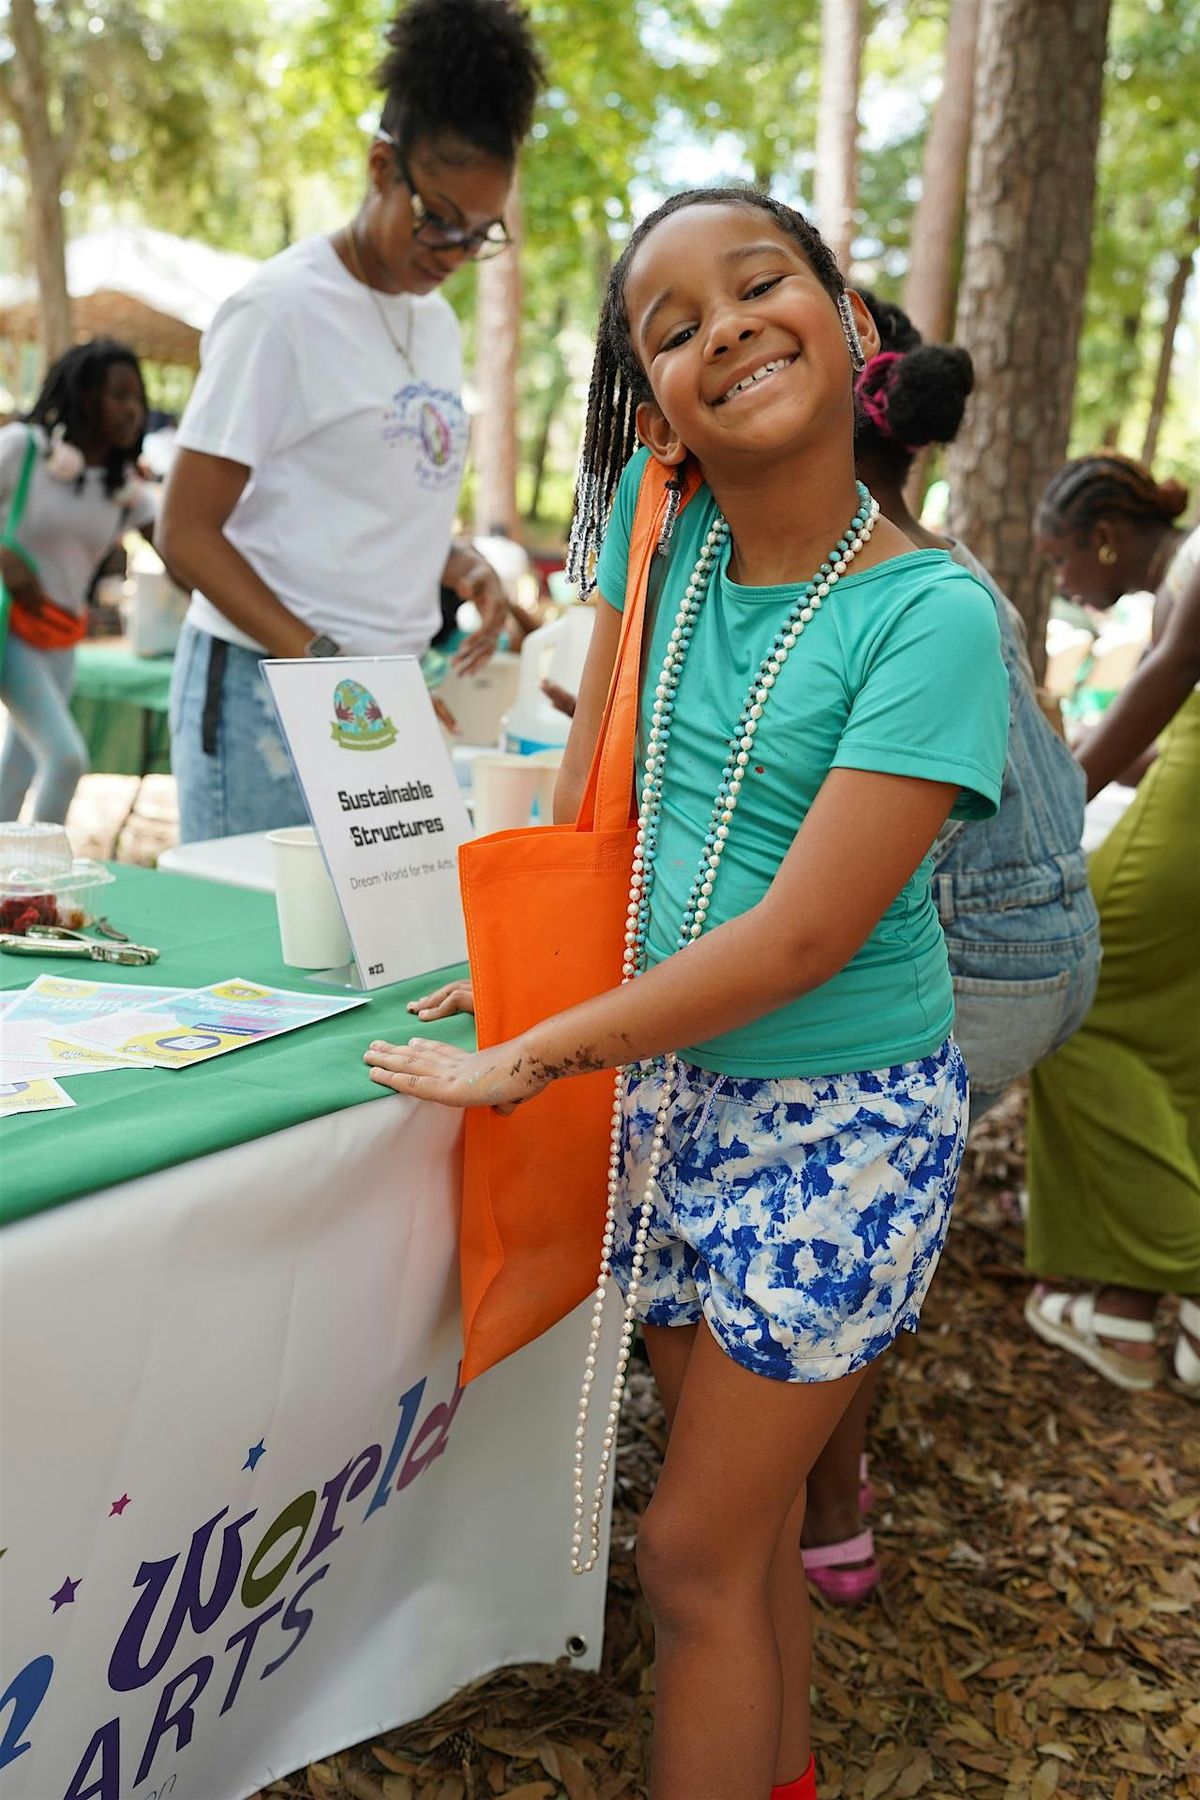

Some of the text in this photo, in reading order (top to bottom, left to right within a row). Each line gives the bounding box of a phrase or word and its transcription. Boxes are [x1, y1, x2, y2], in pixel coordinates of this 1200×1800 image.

[338, 780, 434, 812] Sustainable
[350, 817, 444, 848] Structures
[350, 874, 381, 890] Dream
[381, 867, 409, 883] World
[408, 863, 421, 877] for
[421, 863, 437, 875] the
[368, 963, 385, 976] #23
[108, 1360, 466, 1692] World
[63, 1563, 330, 1800] ARTS
